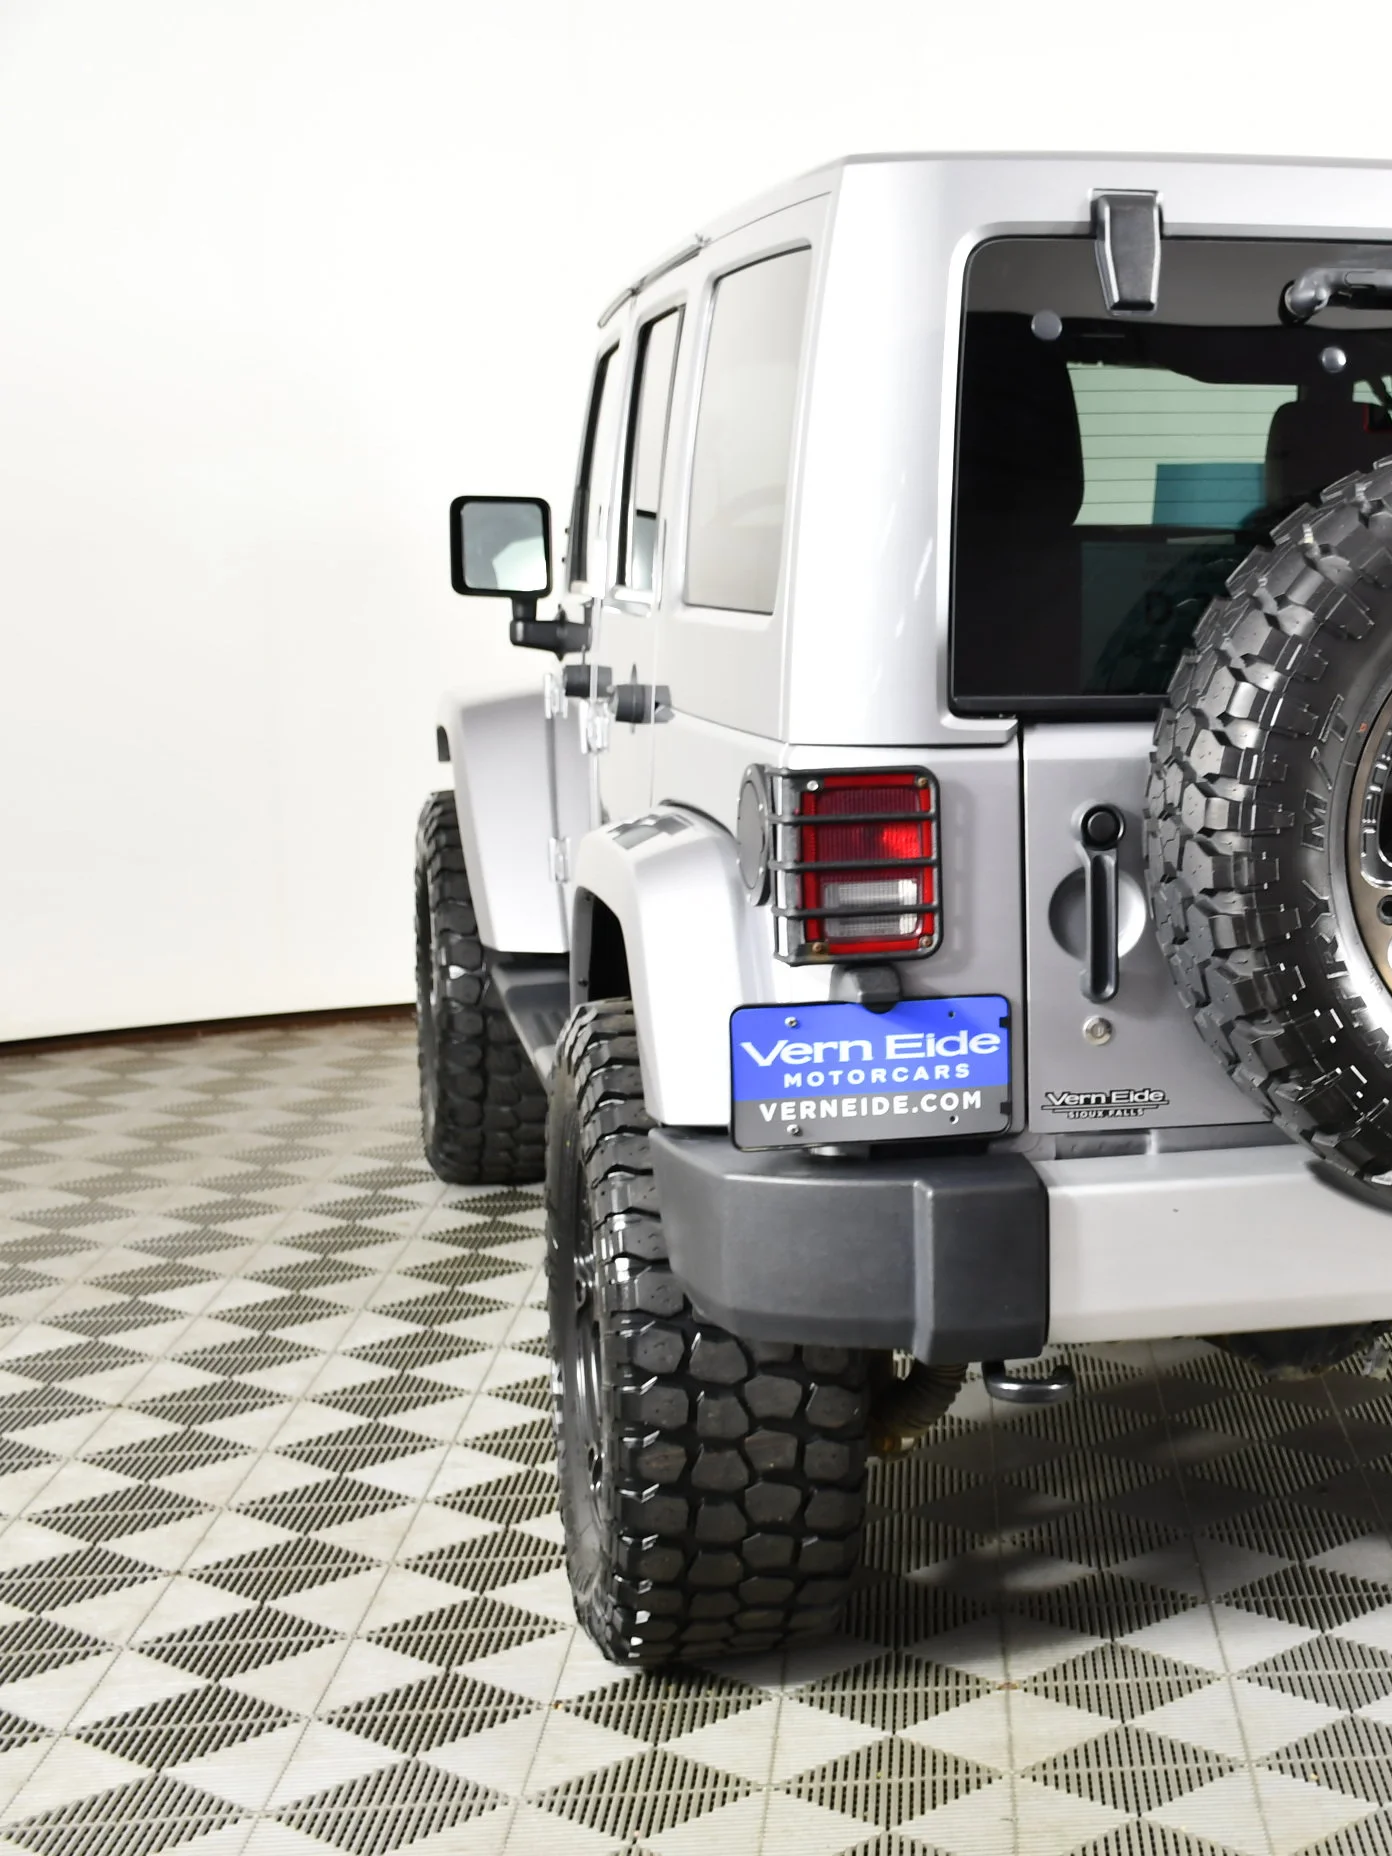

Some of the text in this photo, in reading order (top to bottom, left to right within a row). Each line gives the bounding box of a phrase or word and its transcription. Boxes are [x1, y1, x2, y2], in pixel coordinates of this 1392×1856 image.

[1300, 694, 1348, 852] M/T
[741, 1032, 1000, 1067] Vern Eide
[783, 1063, 970, 1088] MOTORCARS
[759, 1091, 981, 1122] VERNEIDE.COM
[1046, 1089, 1164, 1105] Vern Eide
[1068, 1108, 1144, 1118] SIOUX FALLS
